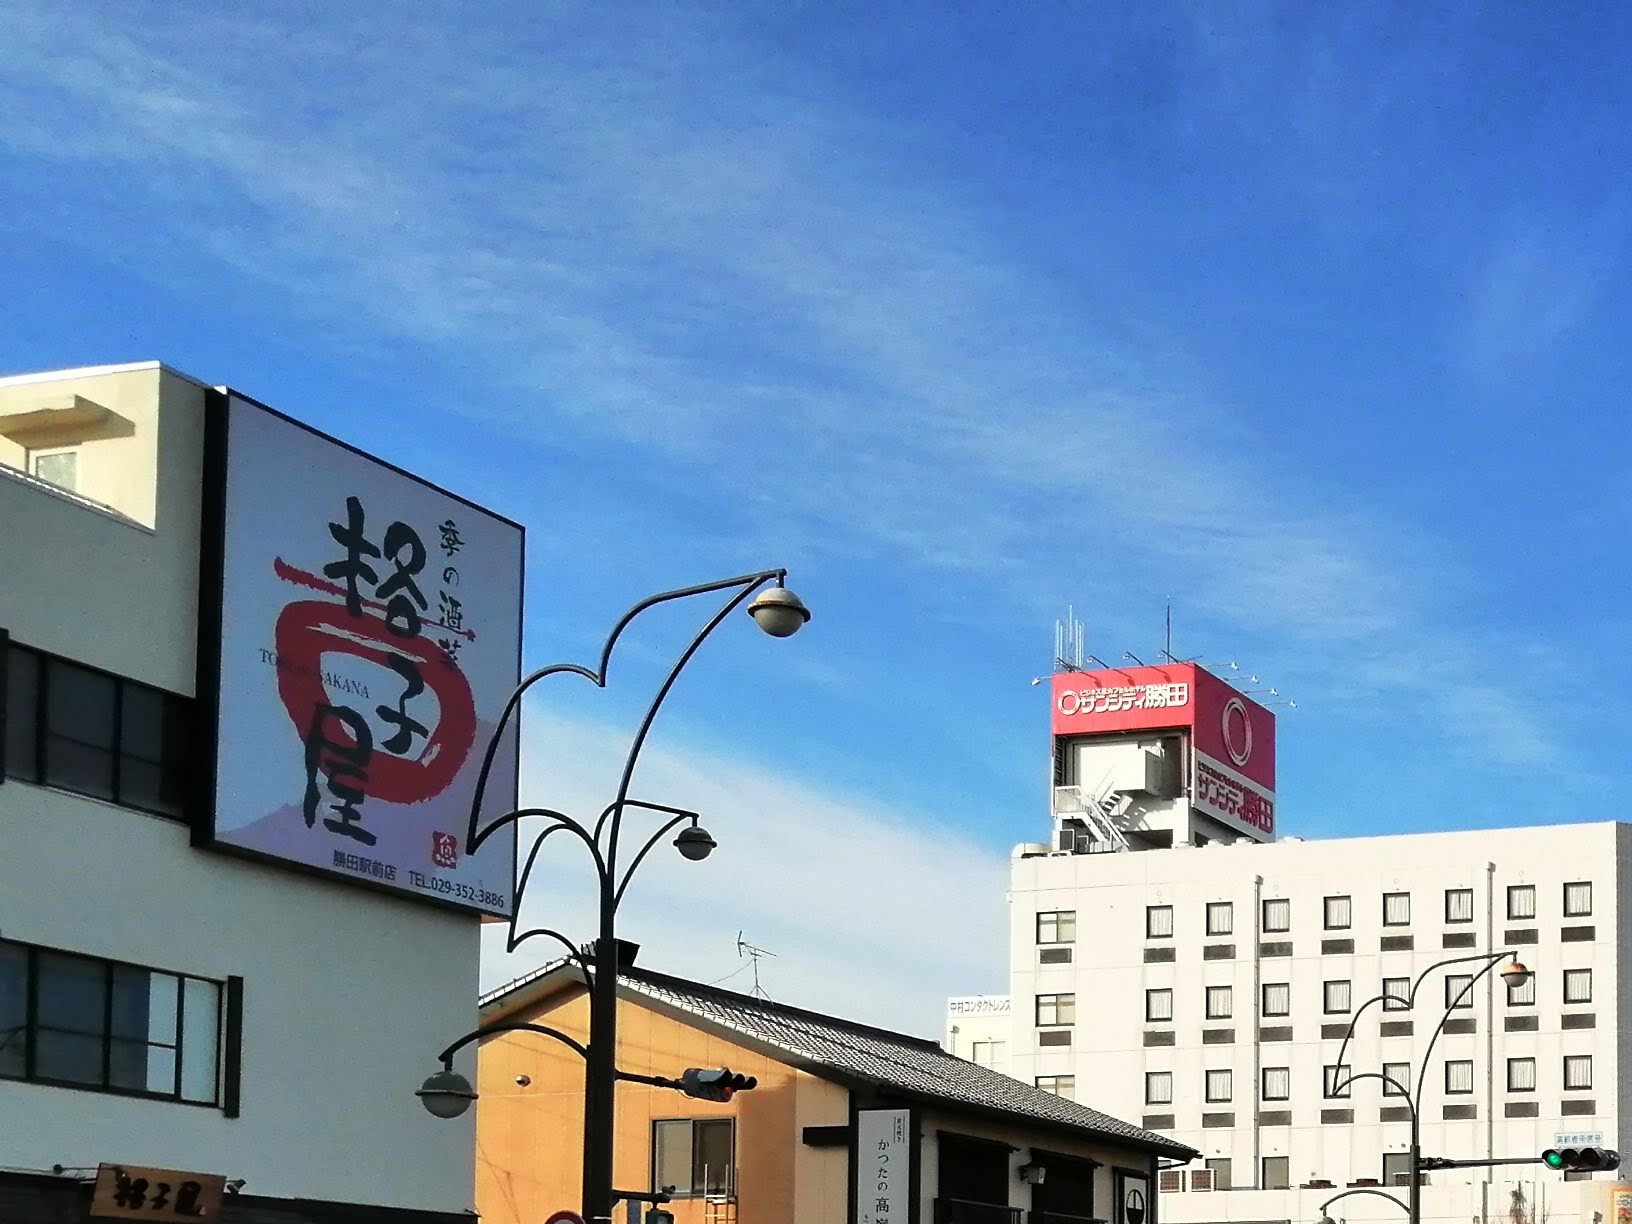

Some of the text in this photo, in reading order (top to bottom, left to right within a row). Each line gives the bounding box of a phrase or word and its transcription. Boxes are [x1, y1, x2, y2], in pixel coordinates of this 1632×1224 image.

[1080, 683, 1189, 714] サンシティ勝田
[1198, 774, 1274, 834] サンシティ勝田
[333, 849, 397, 881] 勝田駅前店
[950, 1000, 1011, 1013] 中村コンタクトレンズ
